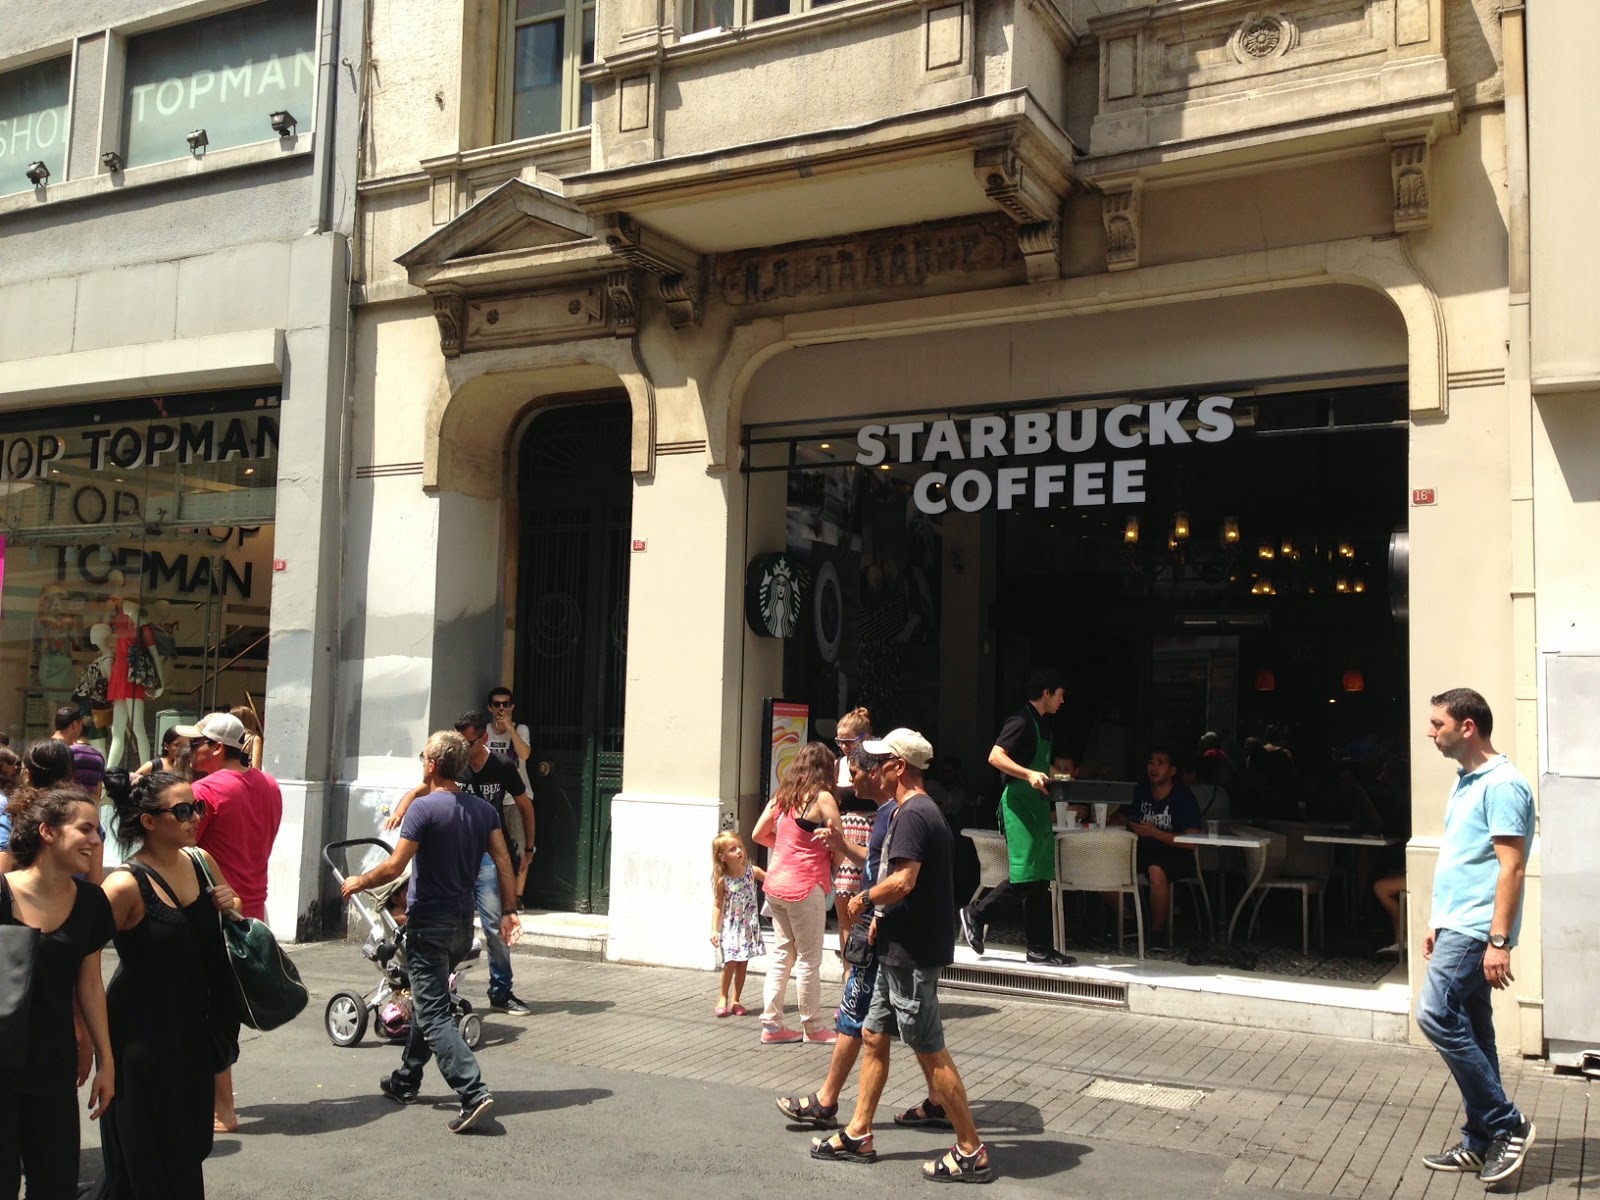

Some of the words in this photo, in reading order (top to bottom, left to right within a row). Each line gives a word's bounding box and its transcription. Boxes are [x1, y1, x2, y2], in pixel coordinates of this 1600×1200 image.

[129, 47, 315, 123] TOPMAN
[0, 435, 65, 480] OP
[82, 416, 278, 471] TOPMAN
[856, 396, 1235, 466] STARBUCKS
[913, 459, 1147, 515] COFFEE
